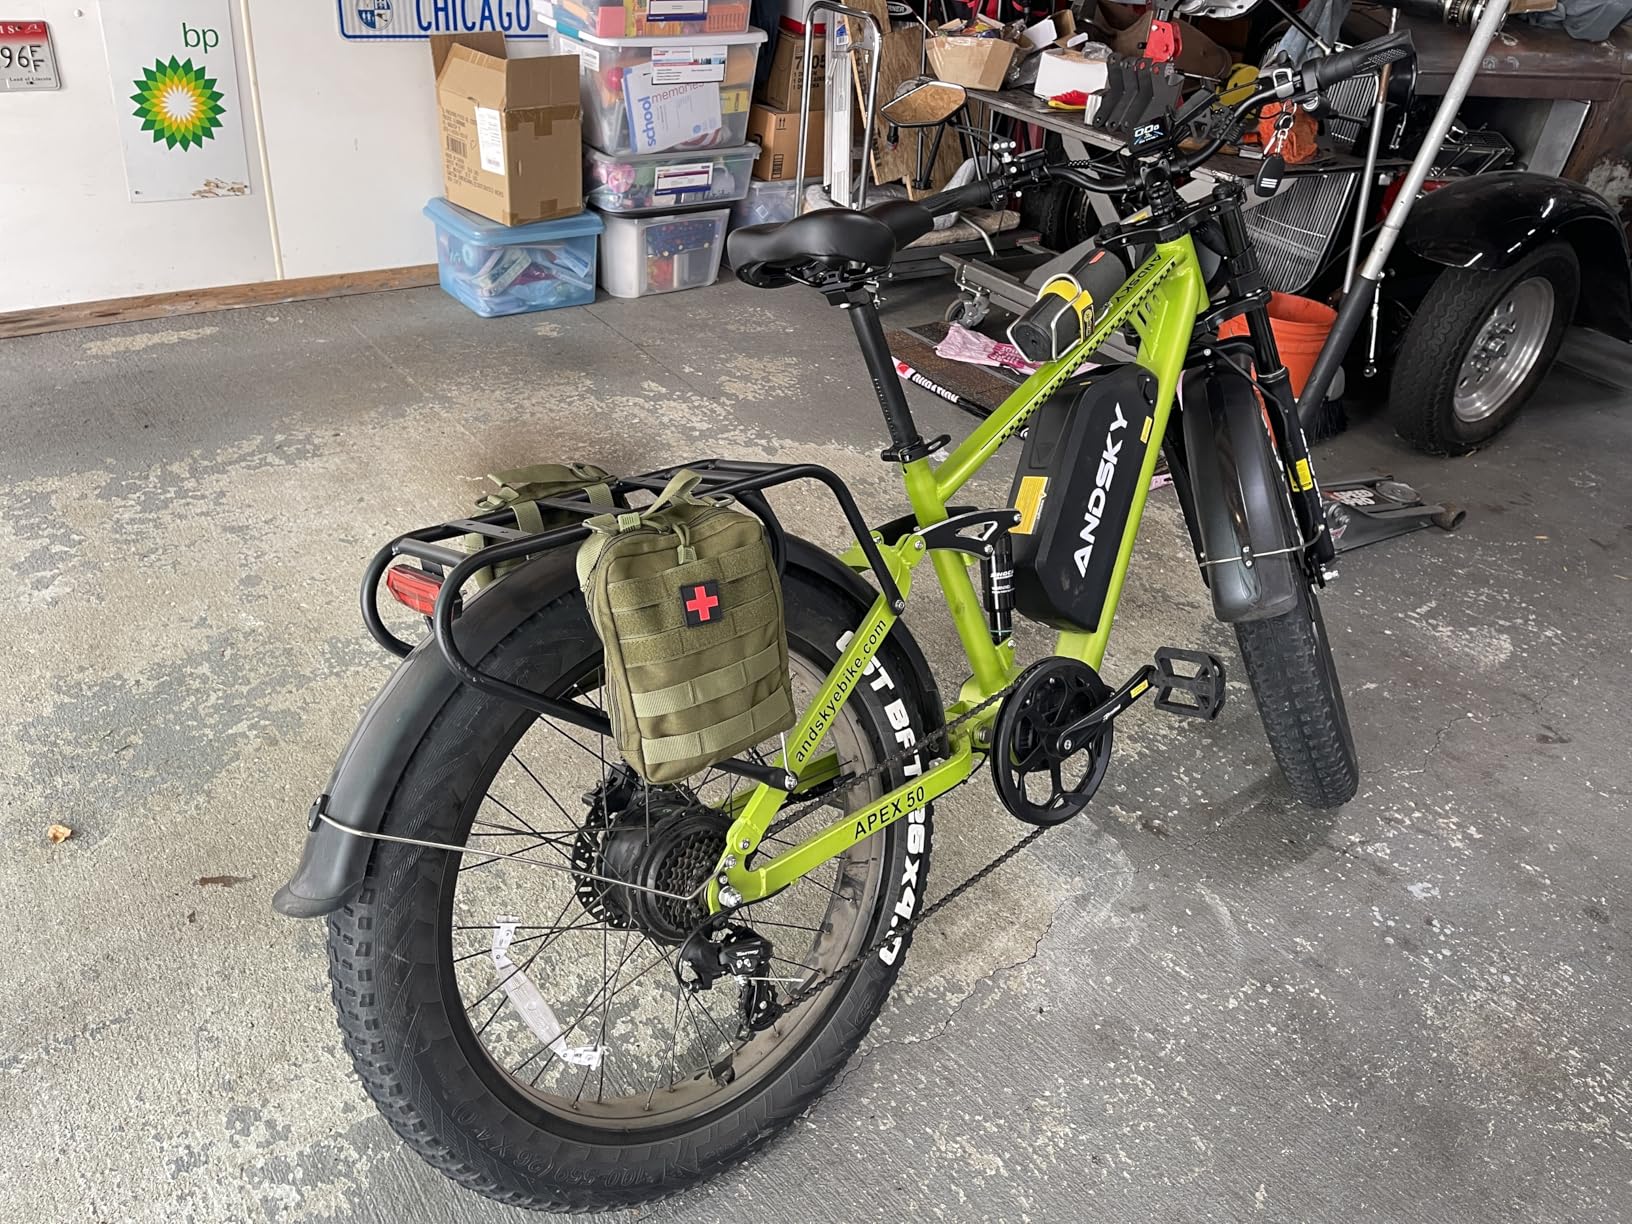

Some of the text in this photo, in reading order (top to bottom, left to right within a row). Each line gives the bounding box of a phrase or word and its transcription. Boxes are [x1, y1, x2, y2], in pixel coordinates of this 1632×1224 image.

[182, 22, 219, 54] bp
[415, 0, 531, 32] CHICAGO
[638, 96, 656, 147] school
[1114, 254, 1162, 303] ANDSKY
[1073, 402, 1128, 579] ANDSKY
[795, 619, 887, 762] andskyebike.com
[854, 786, 925, 841] APEX 50
